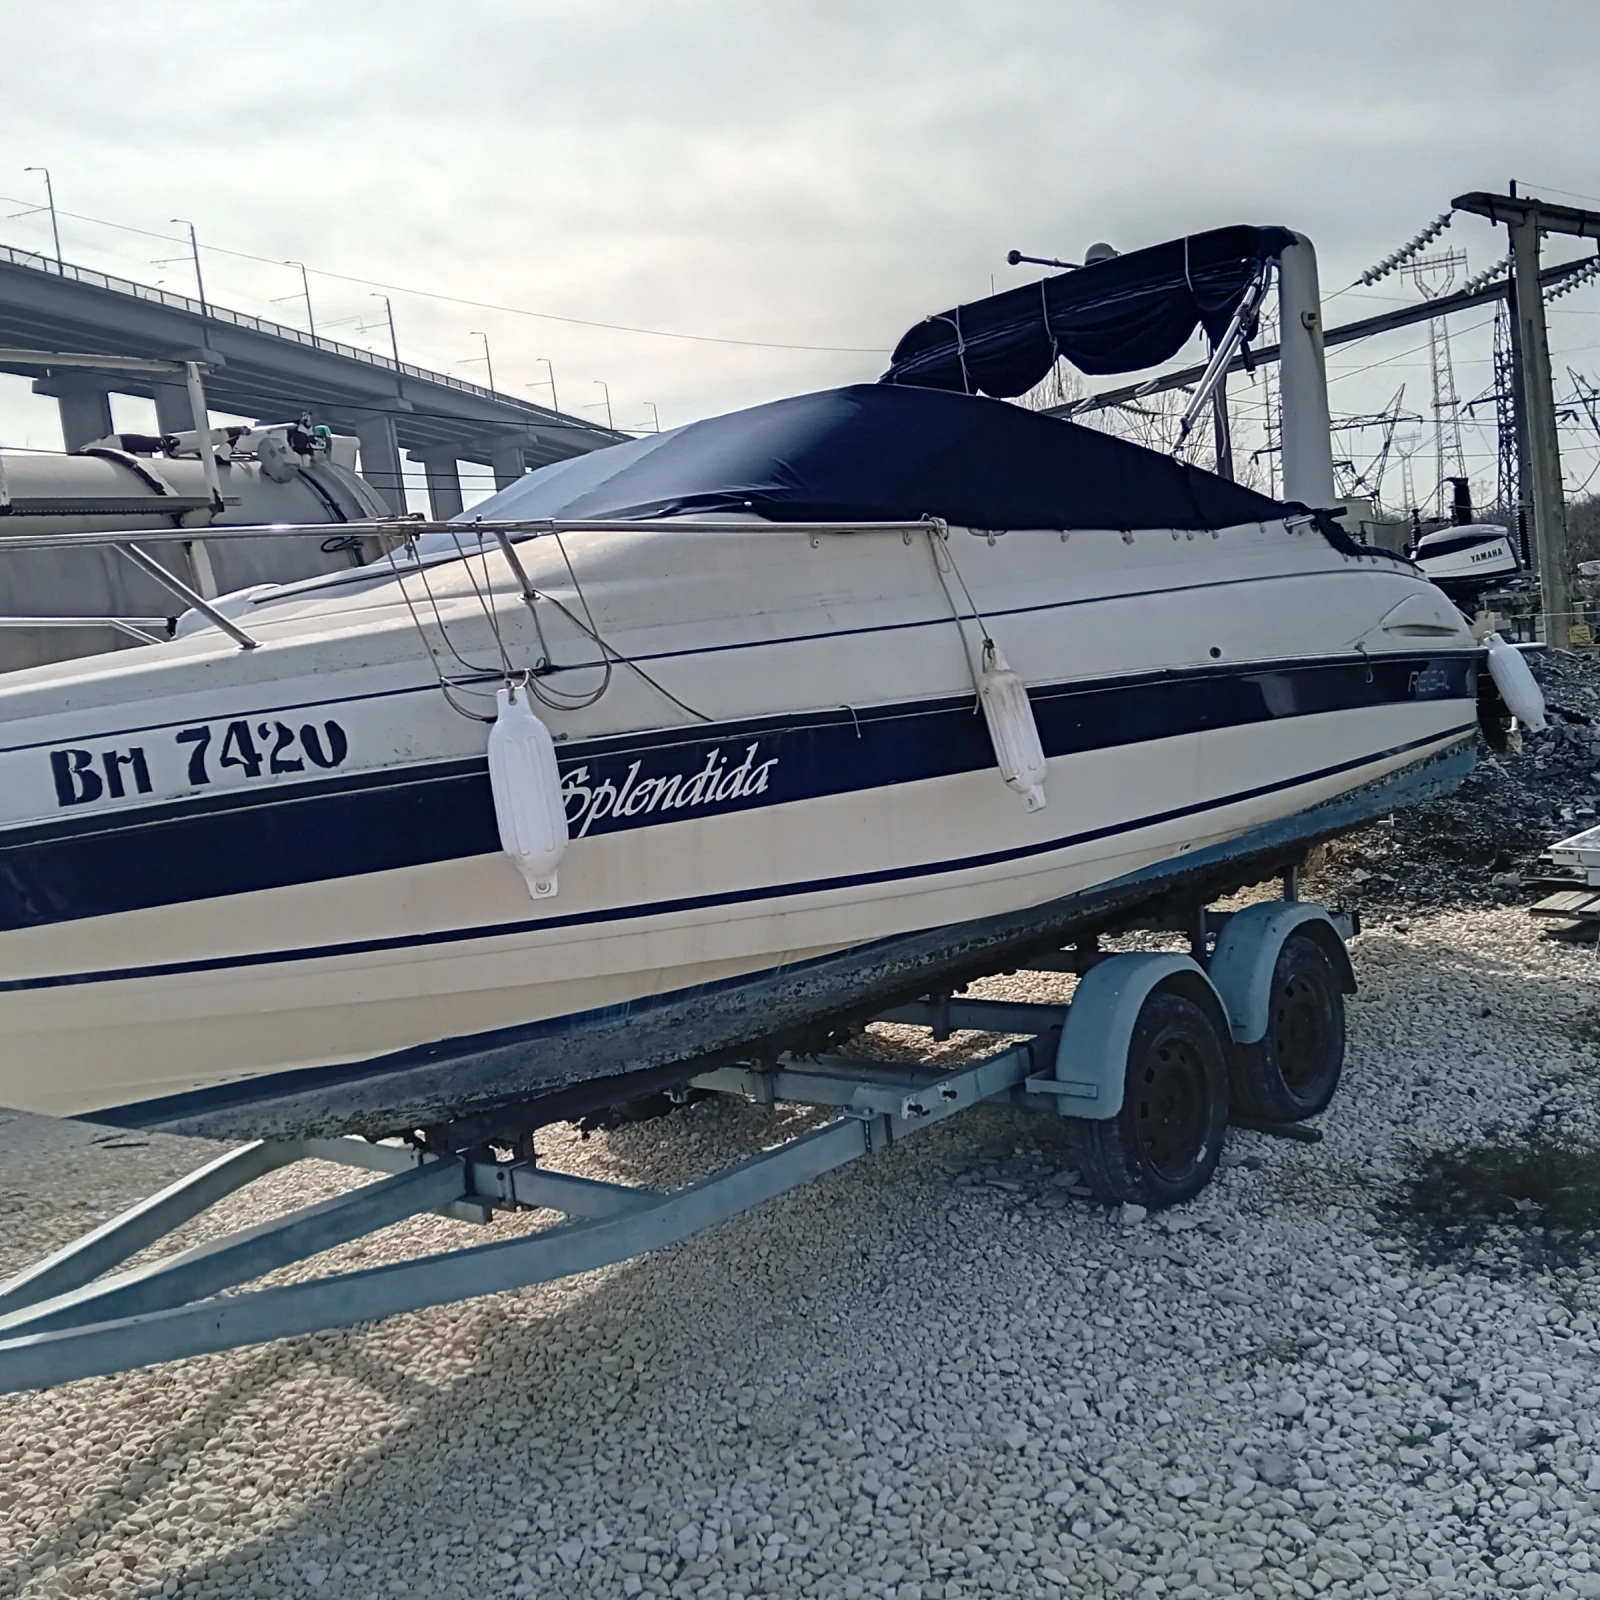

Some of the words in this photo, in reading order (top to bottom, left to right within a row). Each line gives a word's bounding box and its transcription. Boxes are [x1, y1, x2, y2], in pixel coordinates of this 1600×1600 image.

[1470, 547, 1503, 563] YAMAHA
[175, 720, 348, 786] 7420
[560, 741, 779, 839] Splendida
